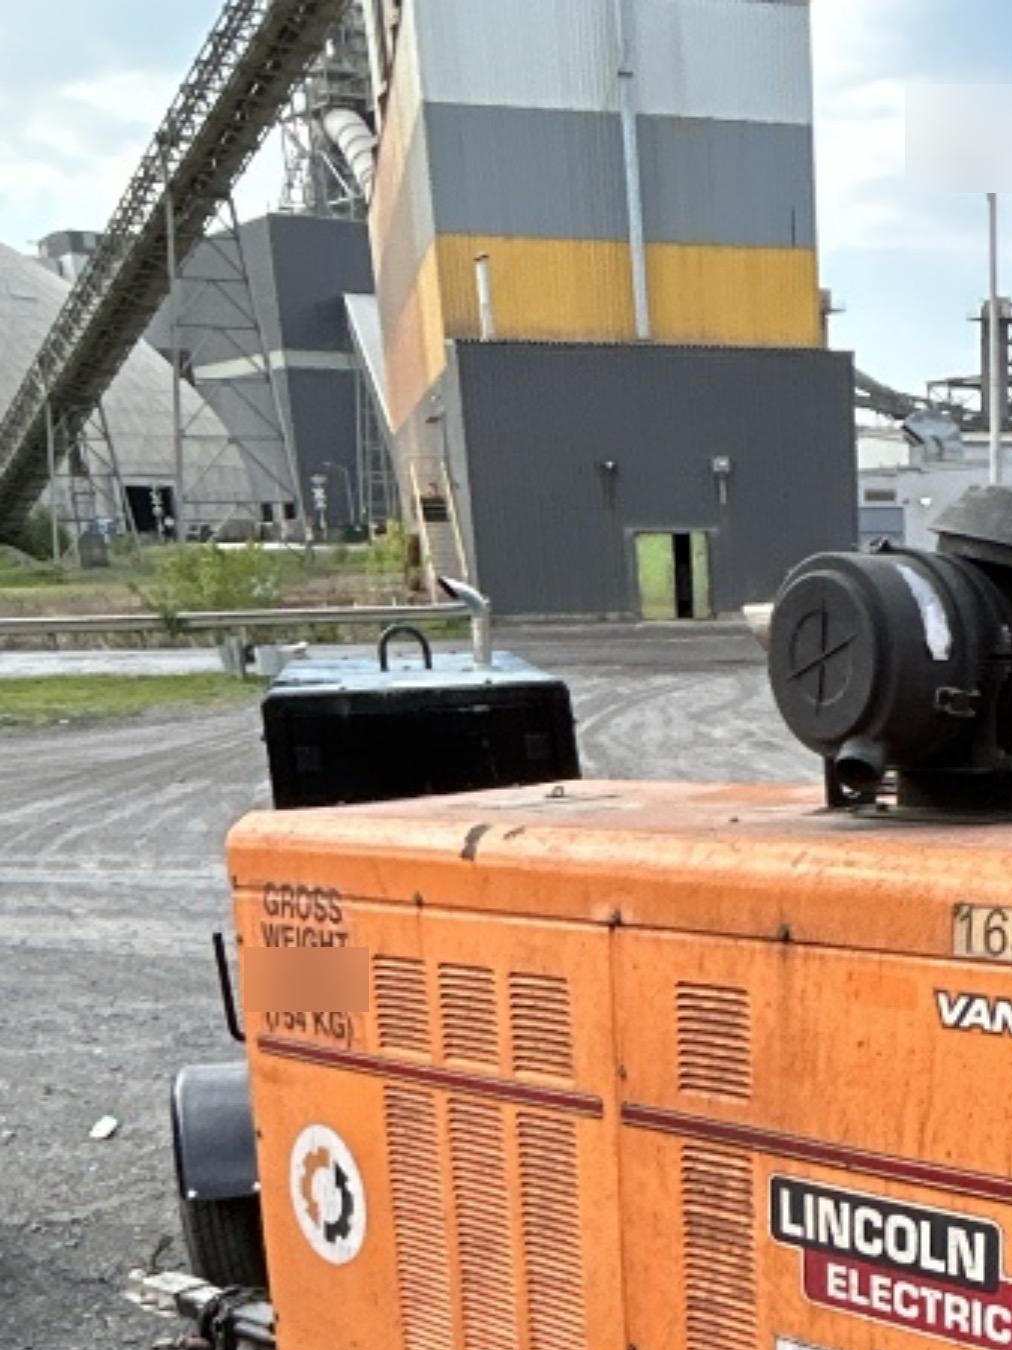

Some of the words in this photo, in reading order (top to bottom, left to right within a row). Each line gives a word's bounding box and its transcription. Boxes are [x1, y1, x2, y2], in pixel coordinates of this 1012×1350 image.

[261, 920, 349, 948] WEIGHT
[263, 882, 343, 924] GROSS
[779, 1187, 986, 1283] LINCOLN
[826, 1261, 1012, 1346] ELECTRIC
